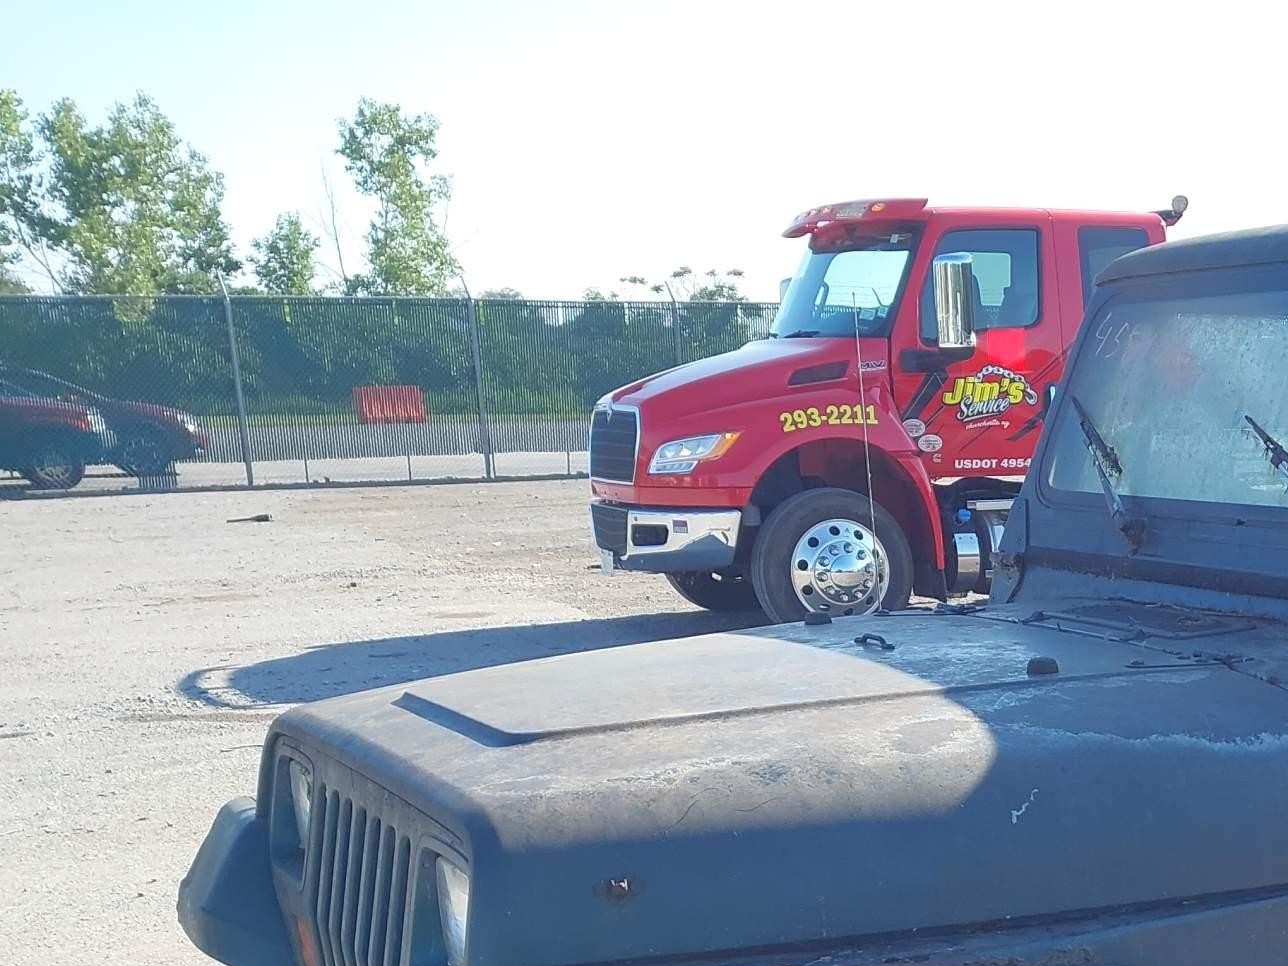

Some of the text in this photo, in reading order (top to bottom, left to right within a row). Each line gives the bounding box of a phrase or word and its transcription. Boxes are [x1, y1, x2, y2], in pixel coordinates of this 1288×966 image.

[942, 375, 1026, 405] Jim's
[780, 404, 878, 432] 293-2211
[957, 395, 1010, 420] Service
[954, 458, 1032, 469] USDOT 4954
